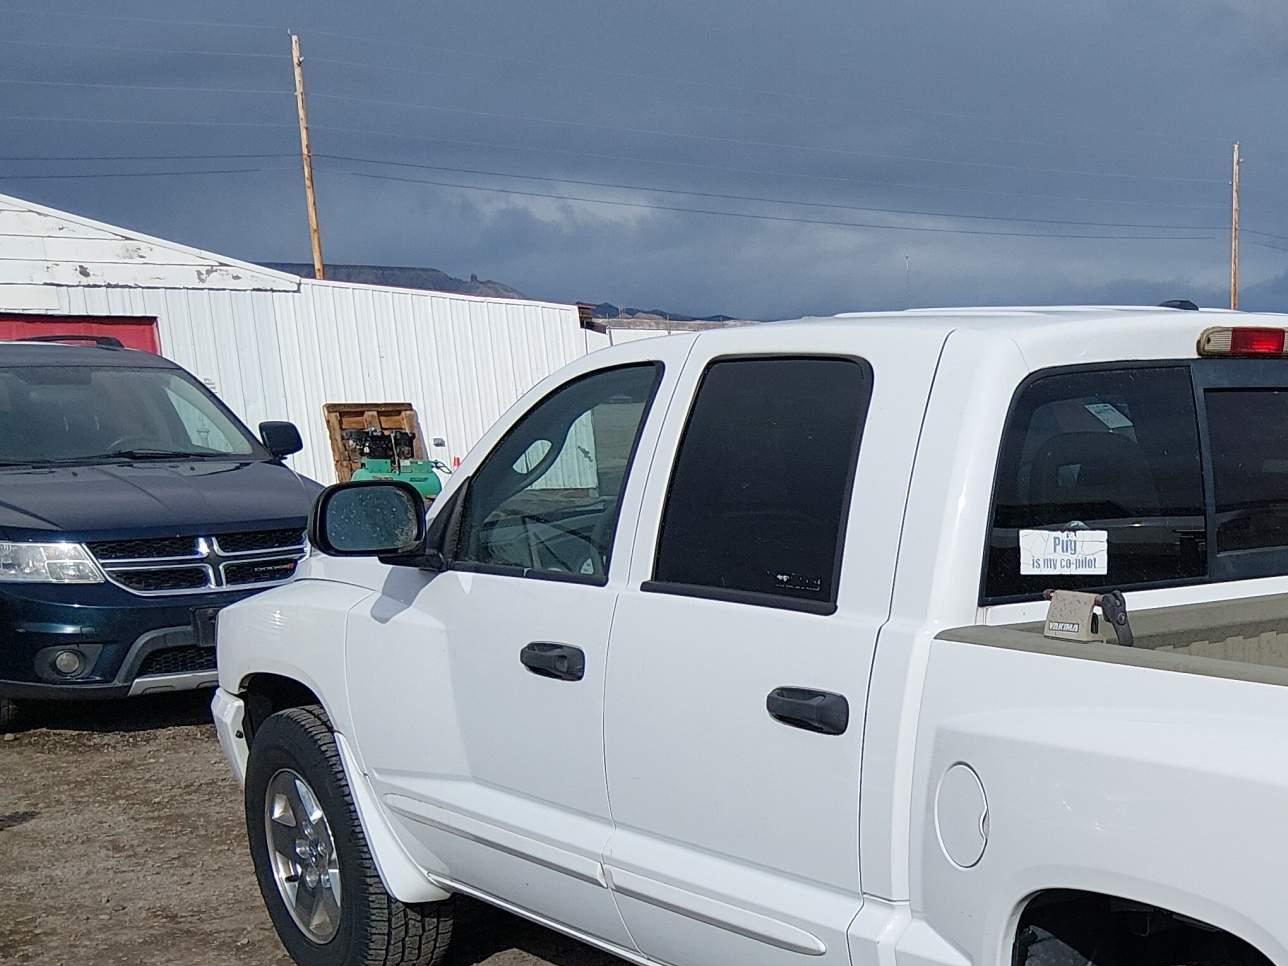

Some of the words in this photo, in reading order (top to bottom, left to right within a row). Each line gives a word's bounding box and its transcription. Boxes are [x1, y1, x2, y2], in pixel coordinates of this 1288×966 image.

[1032, 557, 1041, 569] is
[1043, 557, 1058, 570] my
[1060, 557, 1097, 570] co-pilot
[1049, 622, 1079, 632] YAKIMA
